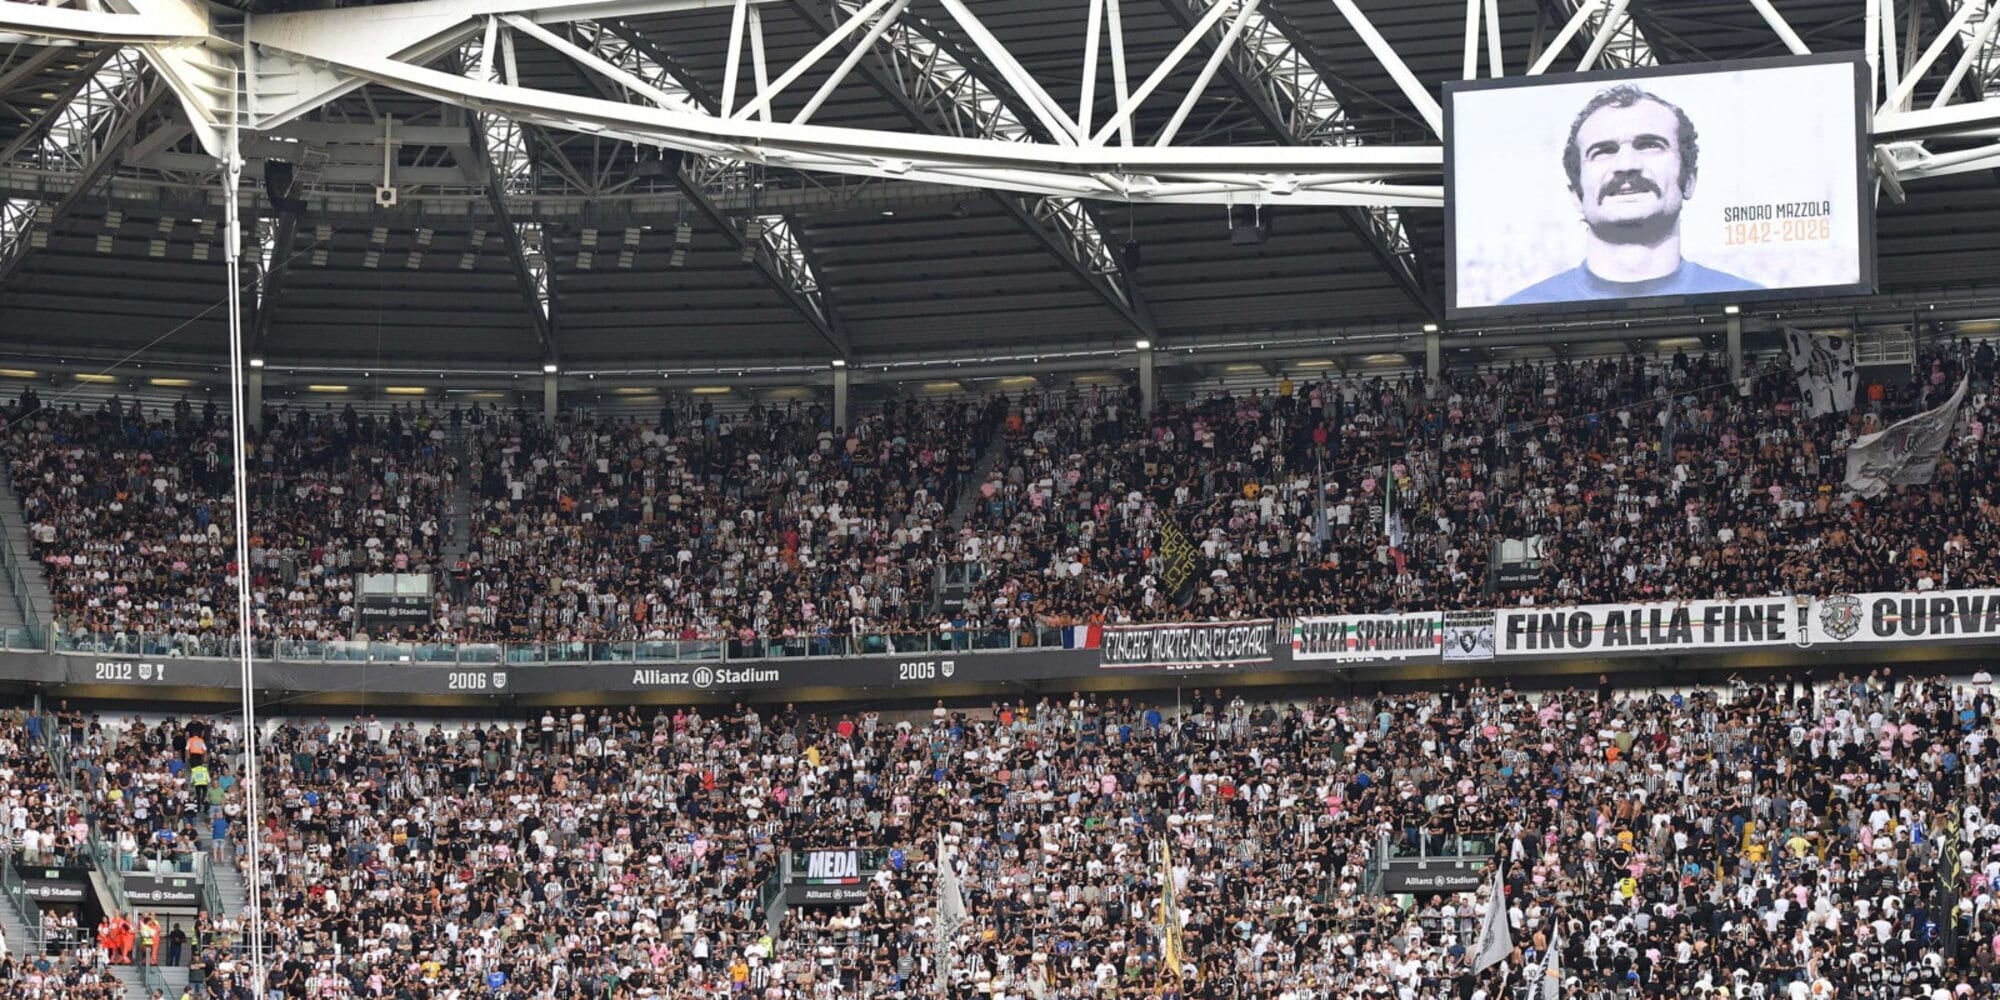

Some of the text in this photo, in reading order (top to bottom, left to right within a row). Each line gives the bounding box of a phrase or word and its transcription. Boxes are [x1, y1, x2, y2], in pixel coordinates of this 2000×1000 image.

[1724, 201, 1830, 222] SANDRO MAZZOLA
[1725, 218, 1830, 246] 1942-2026
[1872, 595, 2000, 637] CURVA
[1299, 622, 1347, 654] SENZA
[1355, 618, 1434, 652] SPERANZA
[1506, 611, 1593, 650] FINO
[1603, 606, 1693, 648] ALLA
[1703, 603, 1785, 643] FINE
[1151, 629, 1190, 659] MORTE
[1190, 628, 1212, 657] NON
[1213, 628, 1226, 657] CI
[95, 662, 132, 680] 2012
[449, 672, 486, 689] 2006
[632, 667, 779, 685] Allianz Stadium
[900, 662, 935, 680] 2005
[808, 850, 857, 878] MEDA
[1405, 876, 1478, 885] Allianz Stadium
[51, 887, 82, 896] Stadium
[806, 890, 832, 898] Allianz
